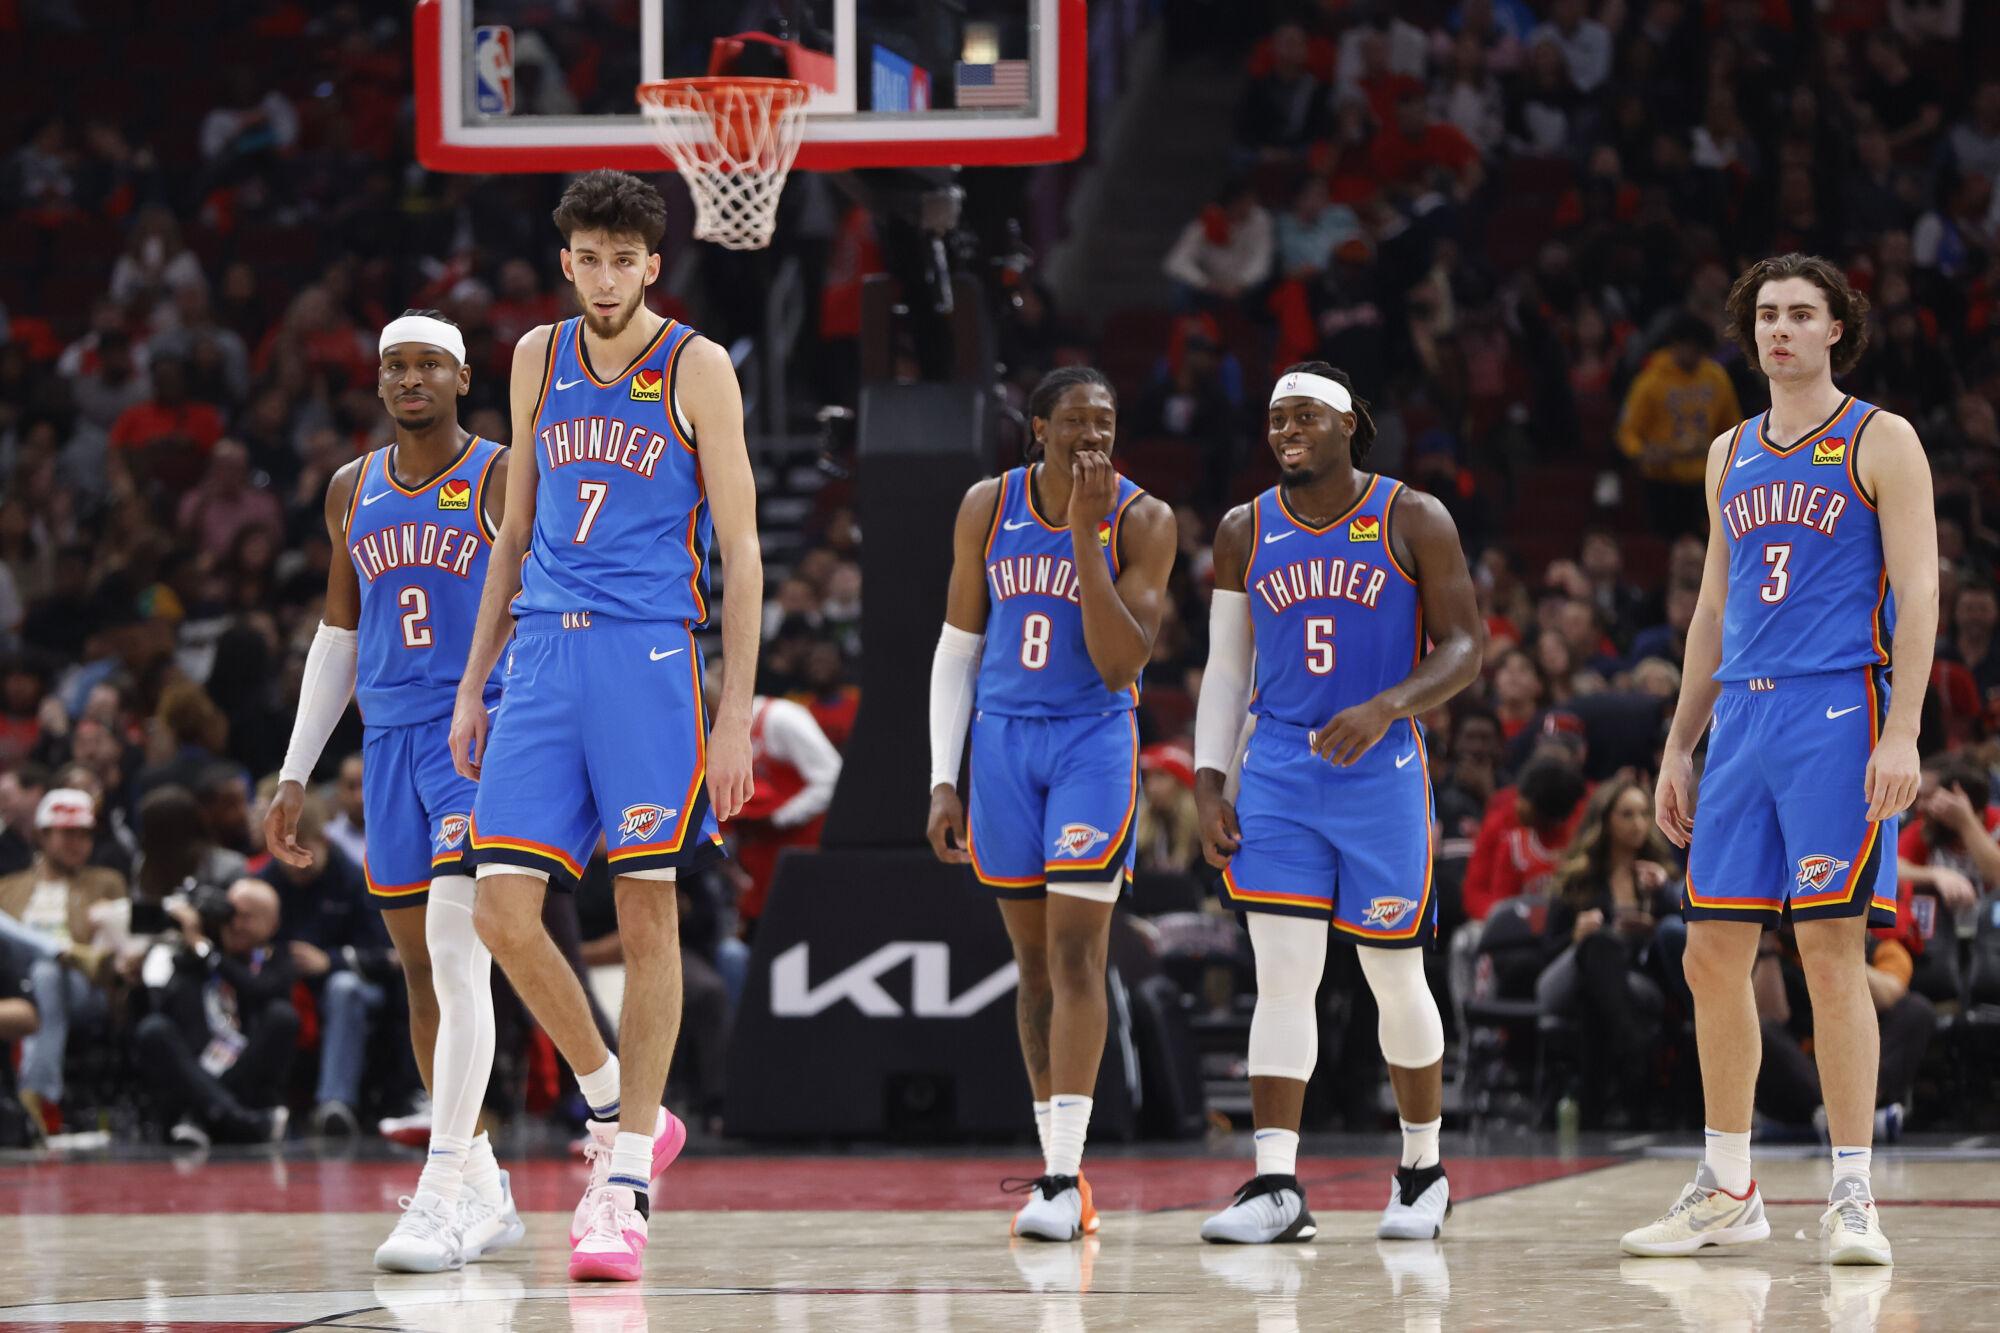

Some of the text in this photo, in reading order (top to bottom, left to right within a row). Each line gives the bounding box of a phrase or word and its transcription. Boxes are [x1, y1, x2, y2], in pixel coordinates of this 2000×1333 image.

[541, 416, 668, 480] THUNDER
[572, 480, 609, 544] 7
[1723, 480, 1848, 542] THUNDER
[352, 522, 480, 583] THUNDER
[1760, 543, 1792, 604] 3
[1254, 557, 1388, 615] THUNDER
[399, 585, 434, 649] 2
[562, 611, 591, 629] OKC
[1020, 611, 1053, 671] 8
[1305, 616, 1335, 676] 5
[627, 810, 655, 834] OKC
[1800, 861, 1829, 884] OKC
